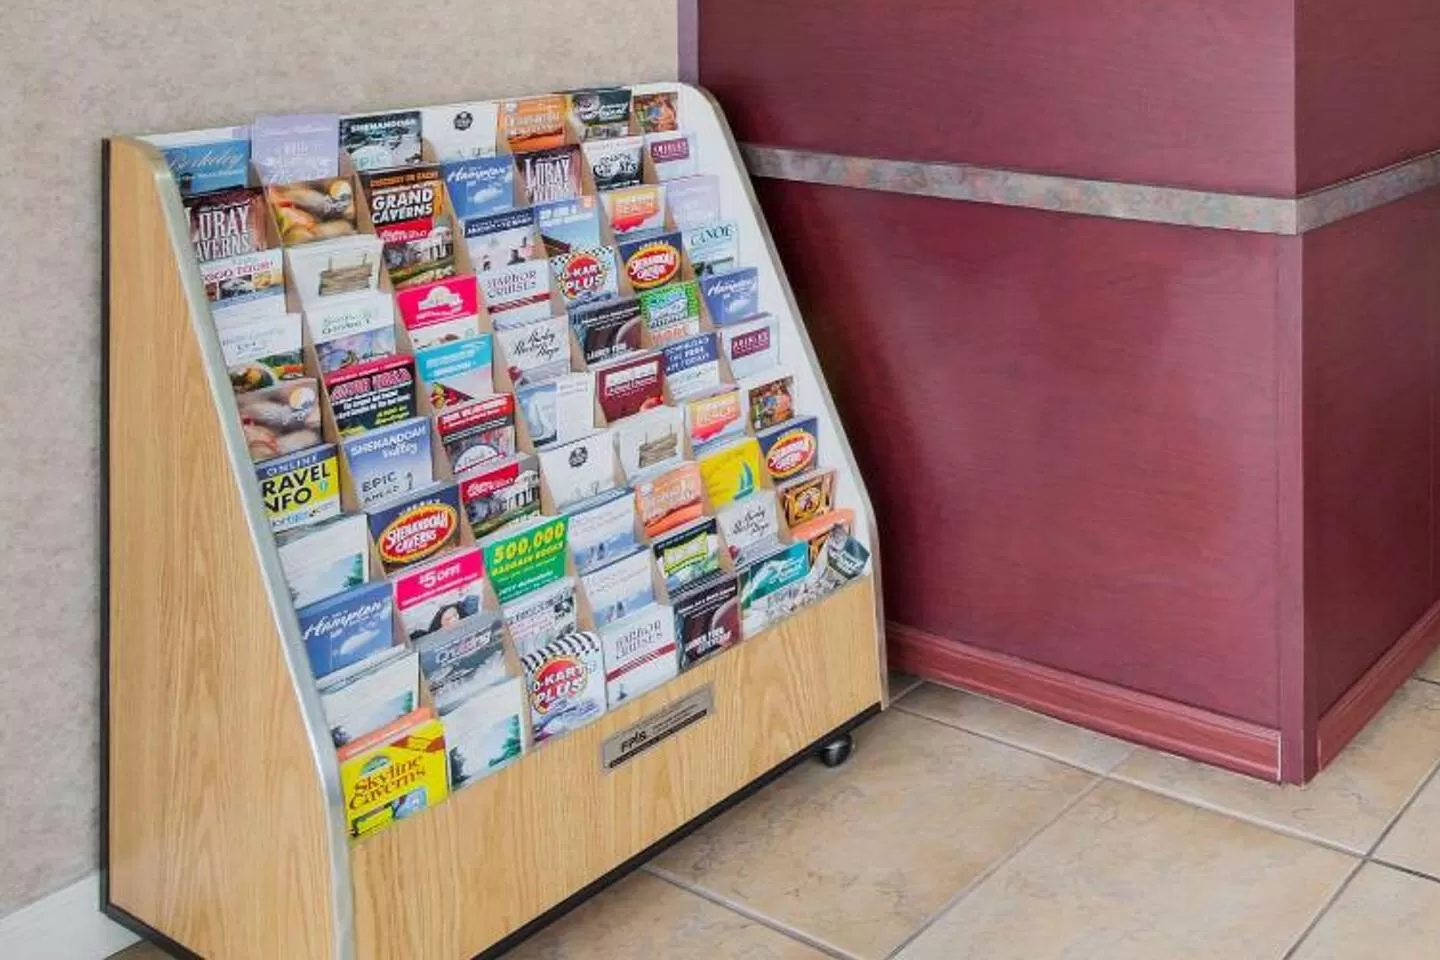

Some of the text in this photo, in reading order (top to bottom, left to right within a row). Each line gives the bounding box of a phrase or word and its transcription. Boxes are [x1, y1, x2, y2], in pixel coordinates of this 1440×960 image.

[523, 156, 571, 189] LURAY
[371, 203, 434, 224] CAVERNS
[372, 189, 434, 210] GRAND
[195, 232, 250, 262] AVERNS
[350, 425, 426, 457] SHENANDOAH
[262, 462, 331, 497] RAVEL
[362, 471, 398, 492] EPIC
[264, 487, 313, 513] NFO
[385, 510, 449, 550] SHENANDOAH
[395, 529, 437, 554] CAVERNS
[492, 520, 566, 564] 500,000
[419, 570, 437, 589] $5
[348, 765, 426, 810] Caverns
[354, 755, 423, 791] Skyline
